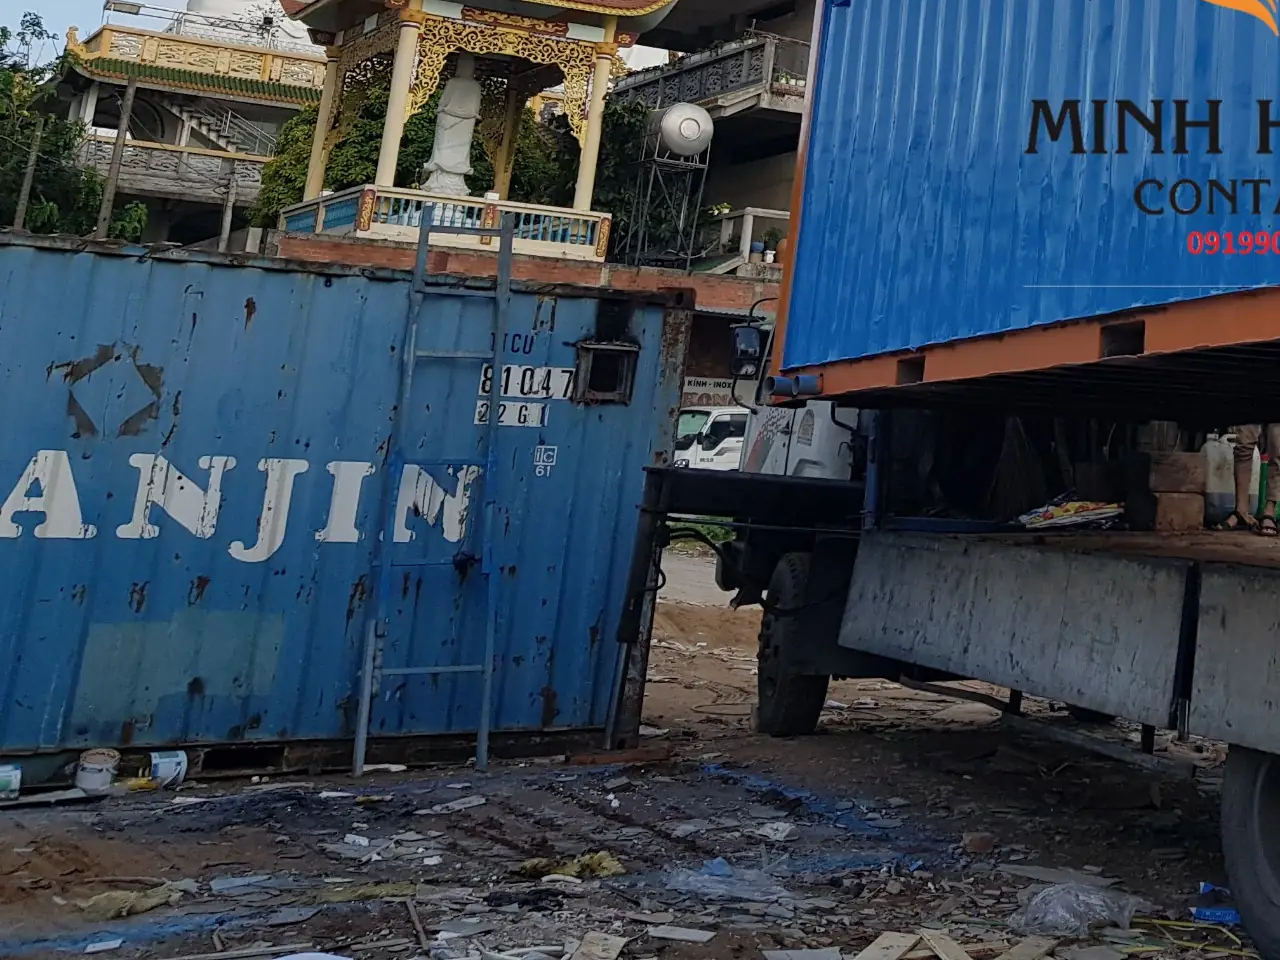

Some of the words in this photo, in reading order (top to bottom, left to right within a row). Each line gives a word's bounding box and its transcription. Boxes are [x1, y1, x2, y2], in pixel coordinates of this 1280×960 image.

[713, 381, 732, 389] INOX
[535, 465, 551, 477] 61
[0, 448, 484, 563] ANJIN
